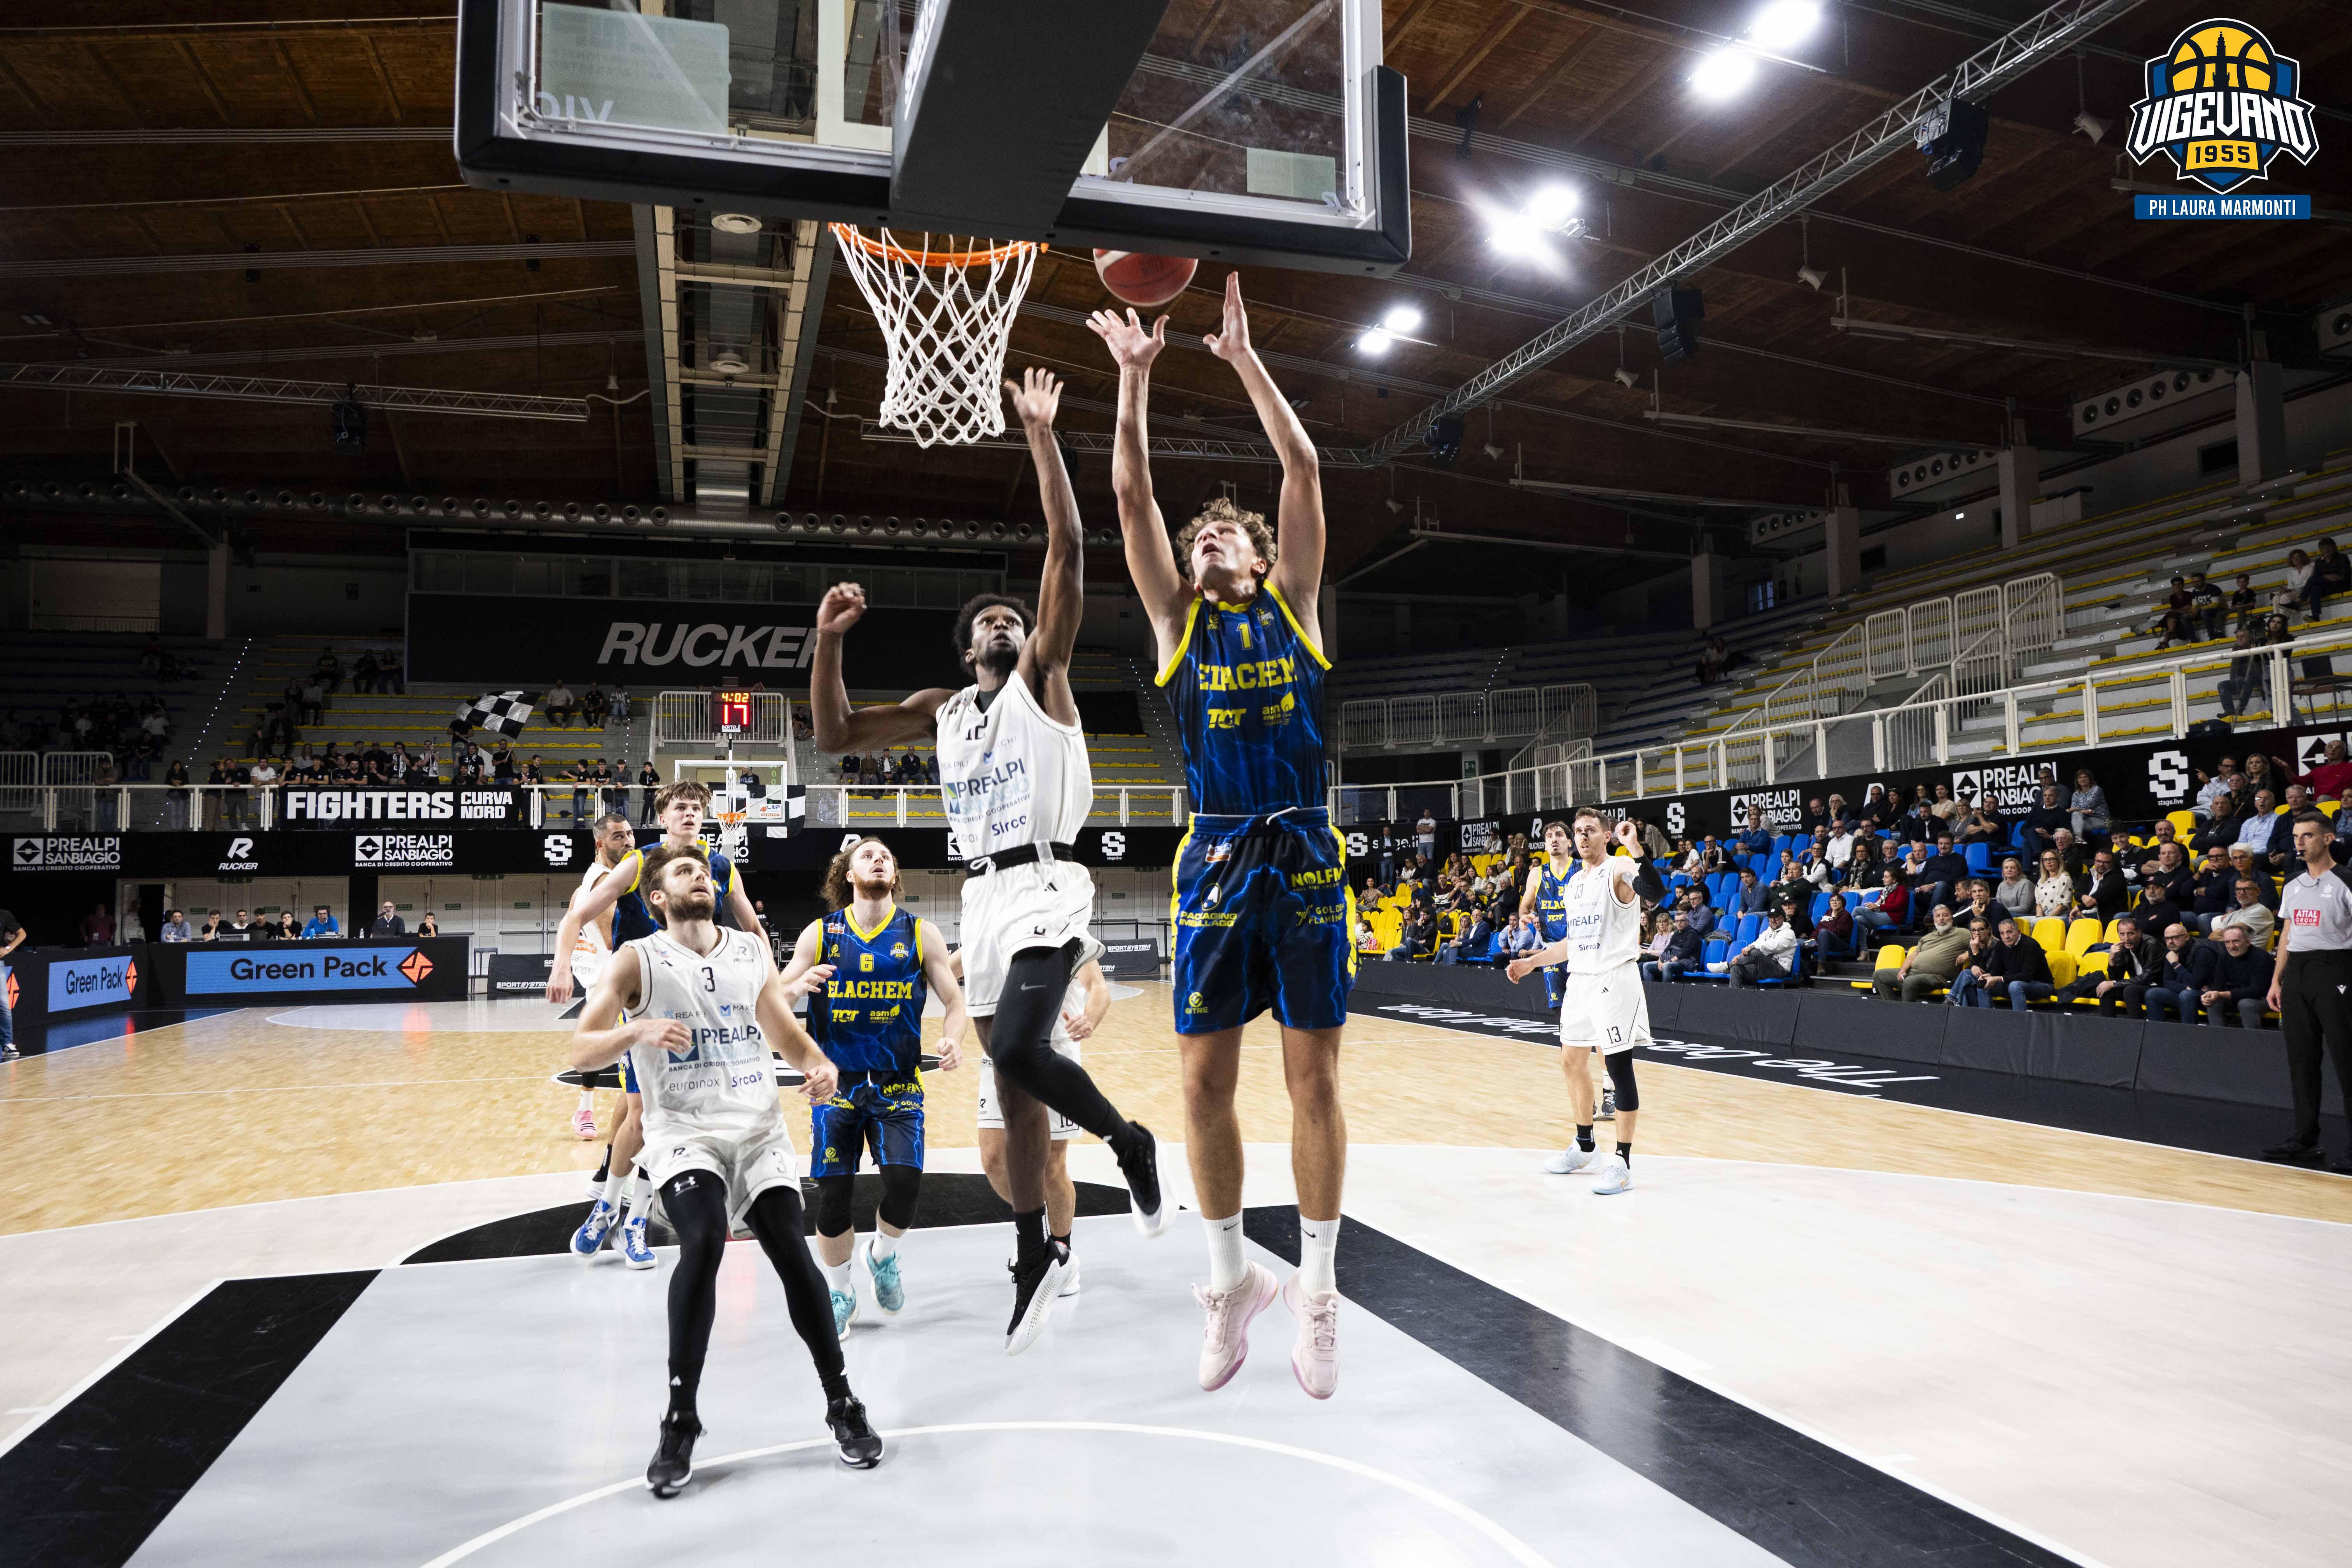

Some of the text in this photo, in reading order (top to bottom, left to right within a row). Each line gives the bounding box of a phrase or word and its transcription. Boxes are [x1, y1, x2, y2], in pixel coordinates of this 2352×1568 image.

[1237, 622, 1253, 650] 1
[722, 692, 749, 703] 4:02
[724, 704, 747, 725] 17
[287, 791, 453, 819] FIGHTERS
[461, 791, 513, 805] CURVA
[1751, 789, 1800, 809] PREALPI
[461, 805, 506, 819] NORD
[47, 838, 120, 851] PREALPI
[386, 835, 452, 848] PREALPI
[46, 852, 120, 864] SANBIAGIO
[385, 849, 453, 861] SANBIAGIO
[1575, 884, 1584, 900] 13
[2296, 910, 2317, 918] ATTAL
[231, 955, 388, 980] Green Pack
[860, 953, 874, 972] 6
[66, 964, 123, 995] Green Pack
[702, 966, 712, 992] 3
[828, 980, 913, 999] ELACHEM
[1606, 1026, 1622, 1044] 13
[732, 1074, 757, 1087] Srca
[1752, 1059, 1941, 1088] The
[669, 1078, 719, 1091] euroinox
